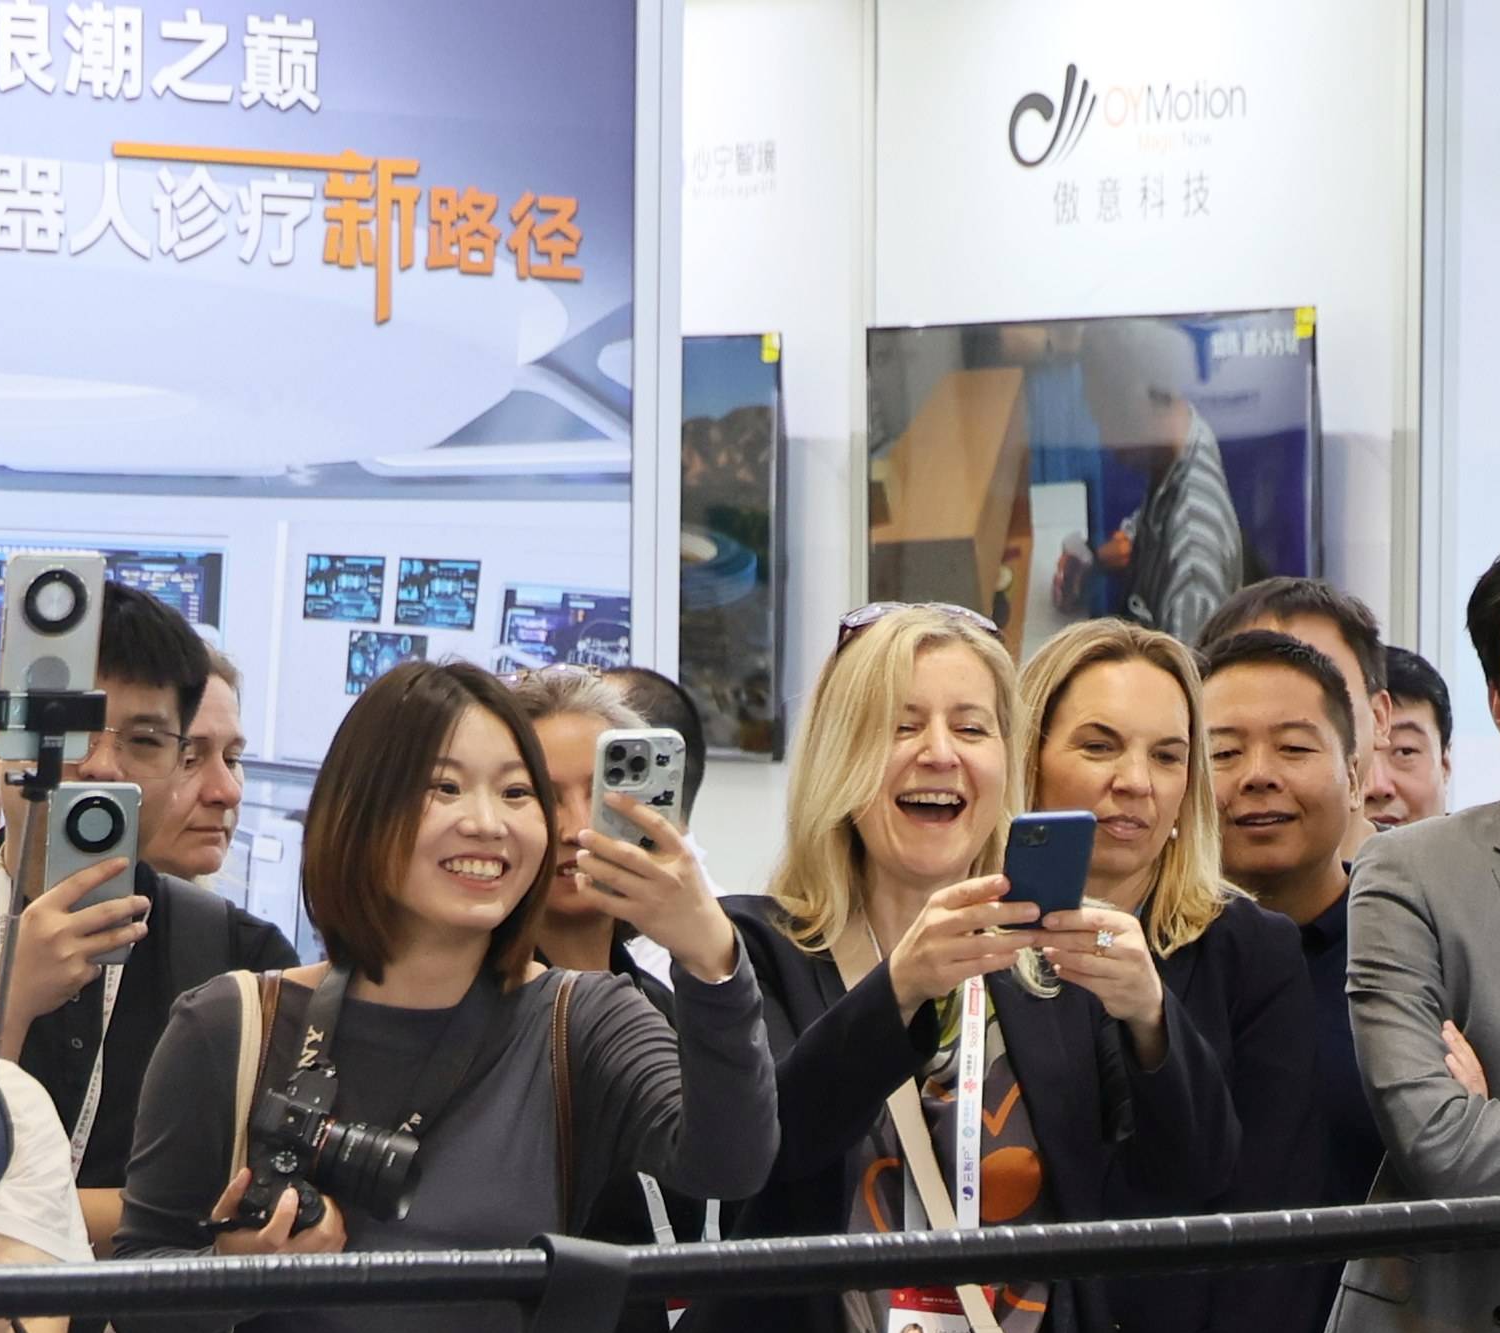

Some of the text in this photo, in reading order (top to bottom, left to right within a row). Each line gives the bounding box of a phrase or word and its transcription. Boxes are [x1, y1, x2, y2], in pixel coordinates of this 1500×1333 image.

[1103, 79, 1248, 129] OYMotion
[1052, 169, 1211, 226] 傲意科技
[296, 1024, 325, 1069] NY
